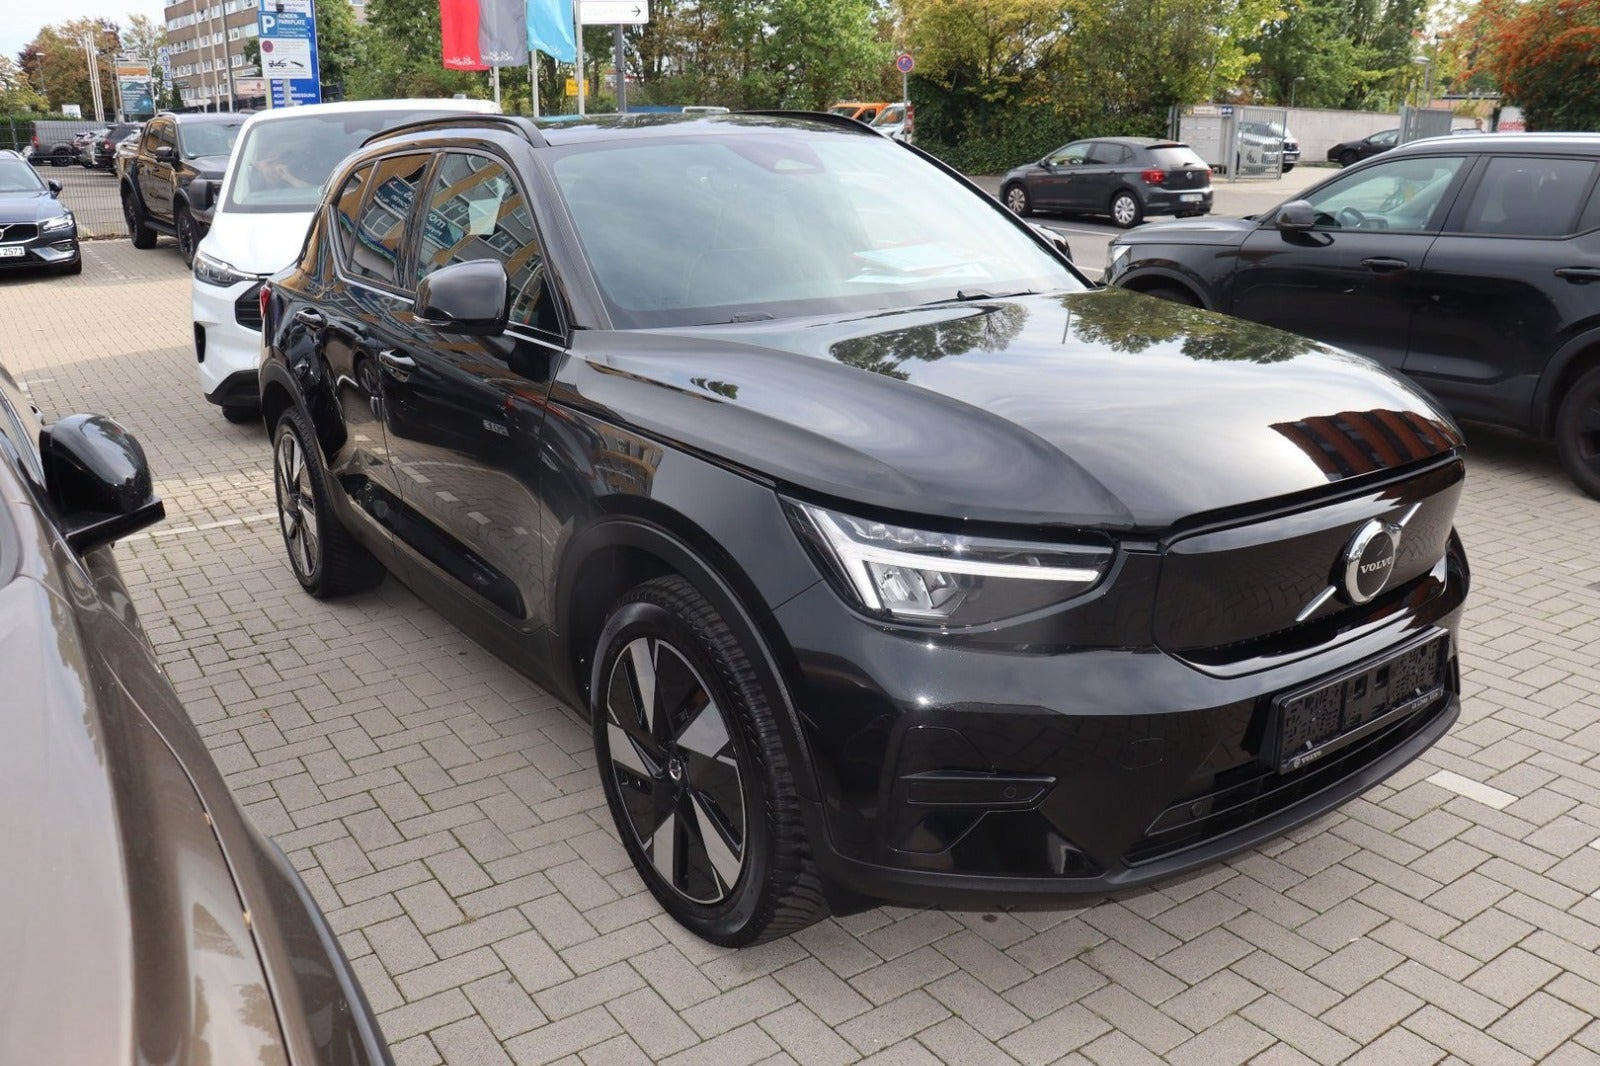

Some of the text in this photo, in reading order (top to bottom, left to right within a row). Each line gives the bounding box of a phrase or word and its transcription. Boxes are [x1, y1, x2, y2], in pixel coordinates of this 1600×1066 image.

[261, 15, 275, 34] P
[161, 47, 172, 88] HOTEL
[3, 247, 24, 256] 2571
[1360, 556, 1393, 574] VOLVO
